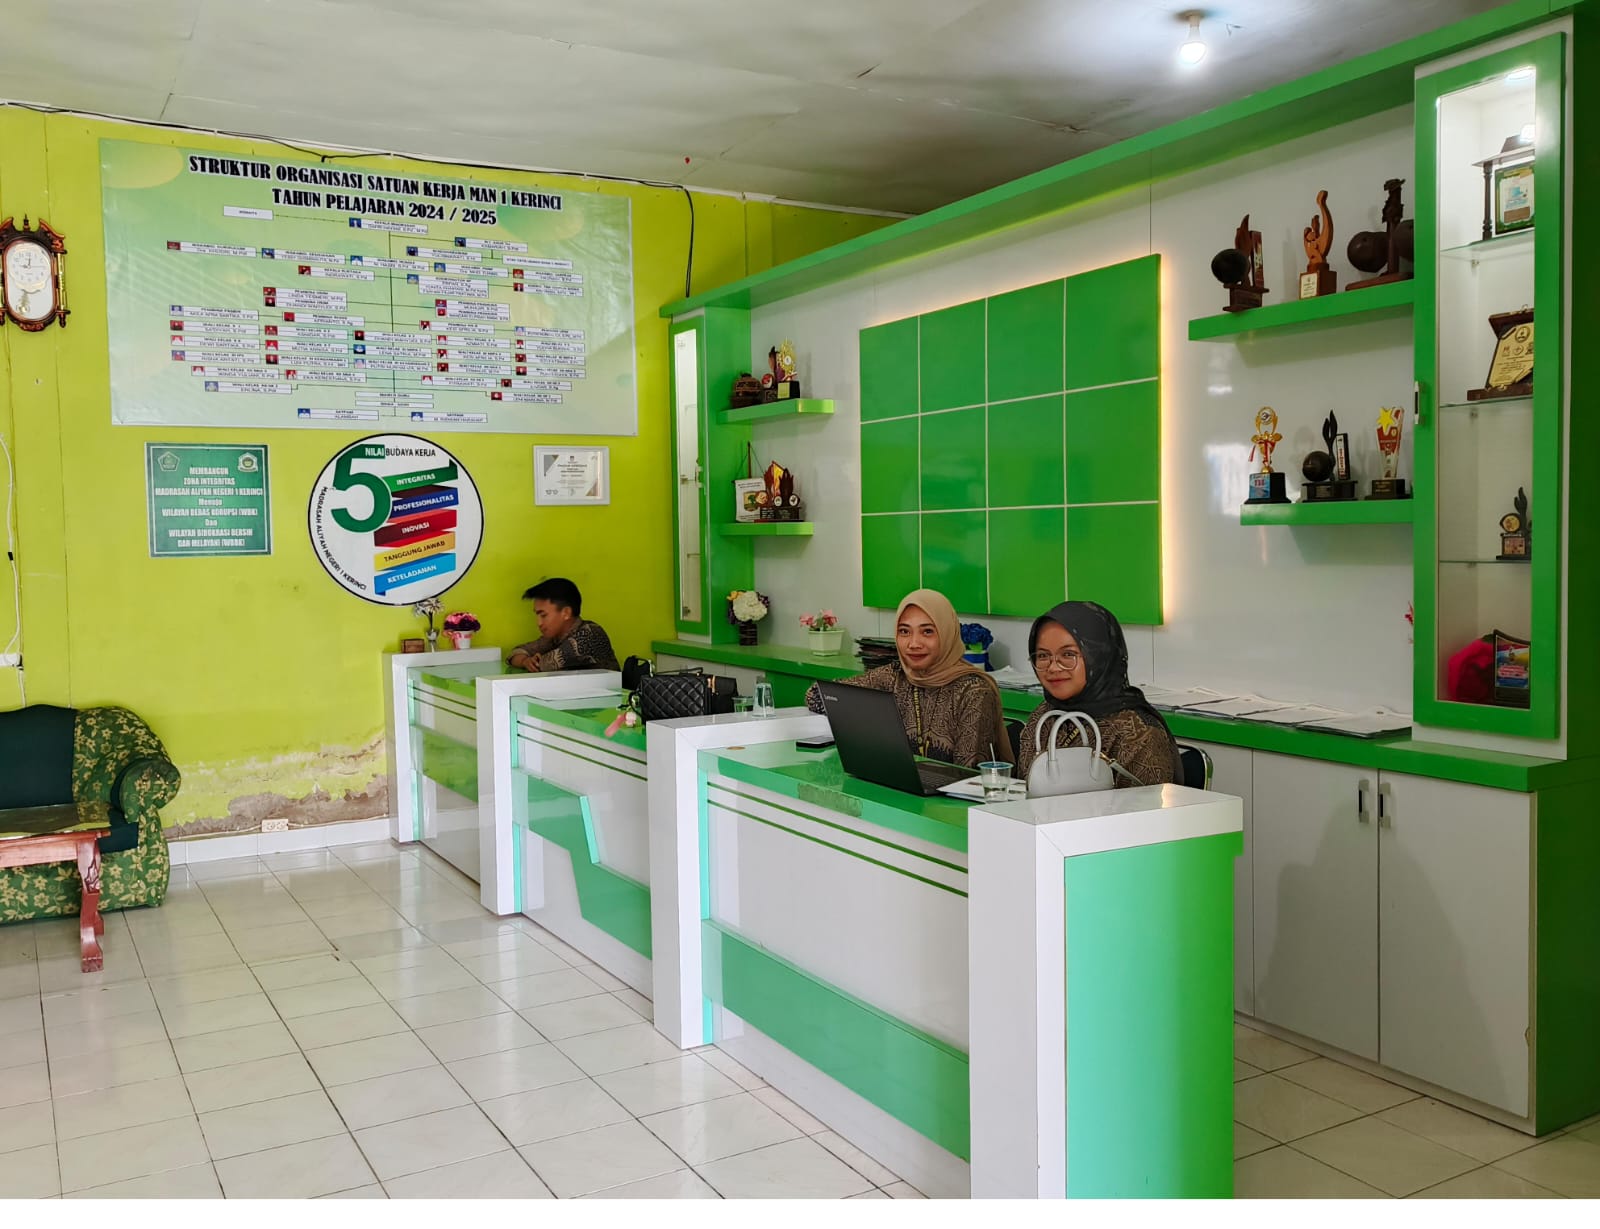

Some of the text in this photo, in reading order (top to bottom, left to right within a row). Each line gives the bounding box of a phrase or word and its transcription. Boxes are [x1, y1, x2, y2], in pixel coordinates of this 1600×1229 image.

[189, 155, 562, 211] STRUKTUR ORGANISASI SATUAN KERJA MAN 1 KERINCI
[272, 188, 497, 225] TAHUN PELAJARAN 2024 / 2025
[365, 447, 436, 457] NILAI BUDAYA KERJA
[200, 478, 235, 486] INTEGRITAS
[396, 473, 436, 486] INTEGRITAS
[155, 488, 190, 496] MADRASAH
[239, 488, 263, 496] KERINCI
[316, 486, 328, 524] MADRASAH
[393, 494, 454, 512] PROFESIONALITAS
[316, 524, 328, 550] ALIYAH
[402, 522, 430, 534] INOVASI
[324, 550, 342, 572] NEGERI
[384, 540, 446, 563] TANGGUNG JAWAB
[342, 572, 367, 591] KERINCI
[387, 564, 437, 584] KETELADANAN
